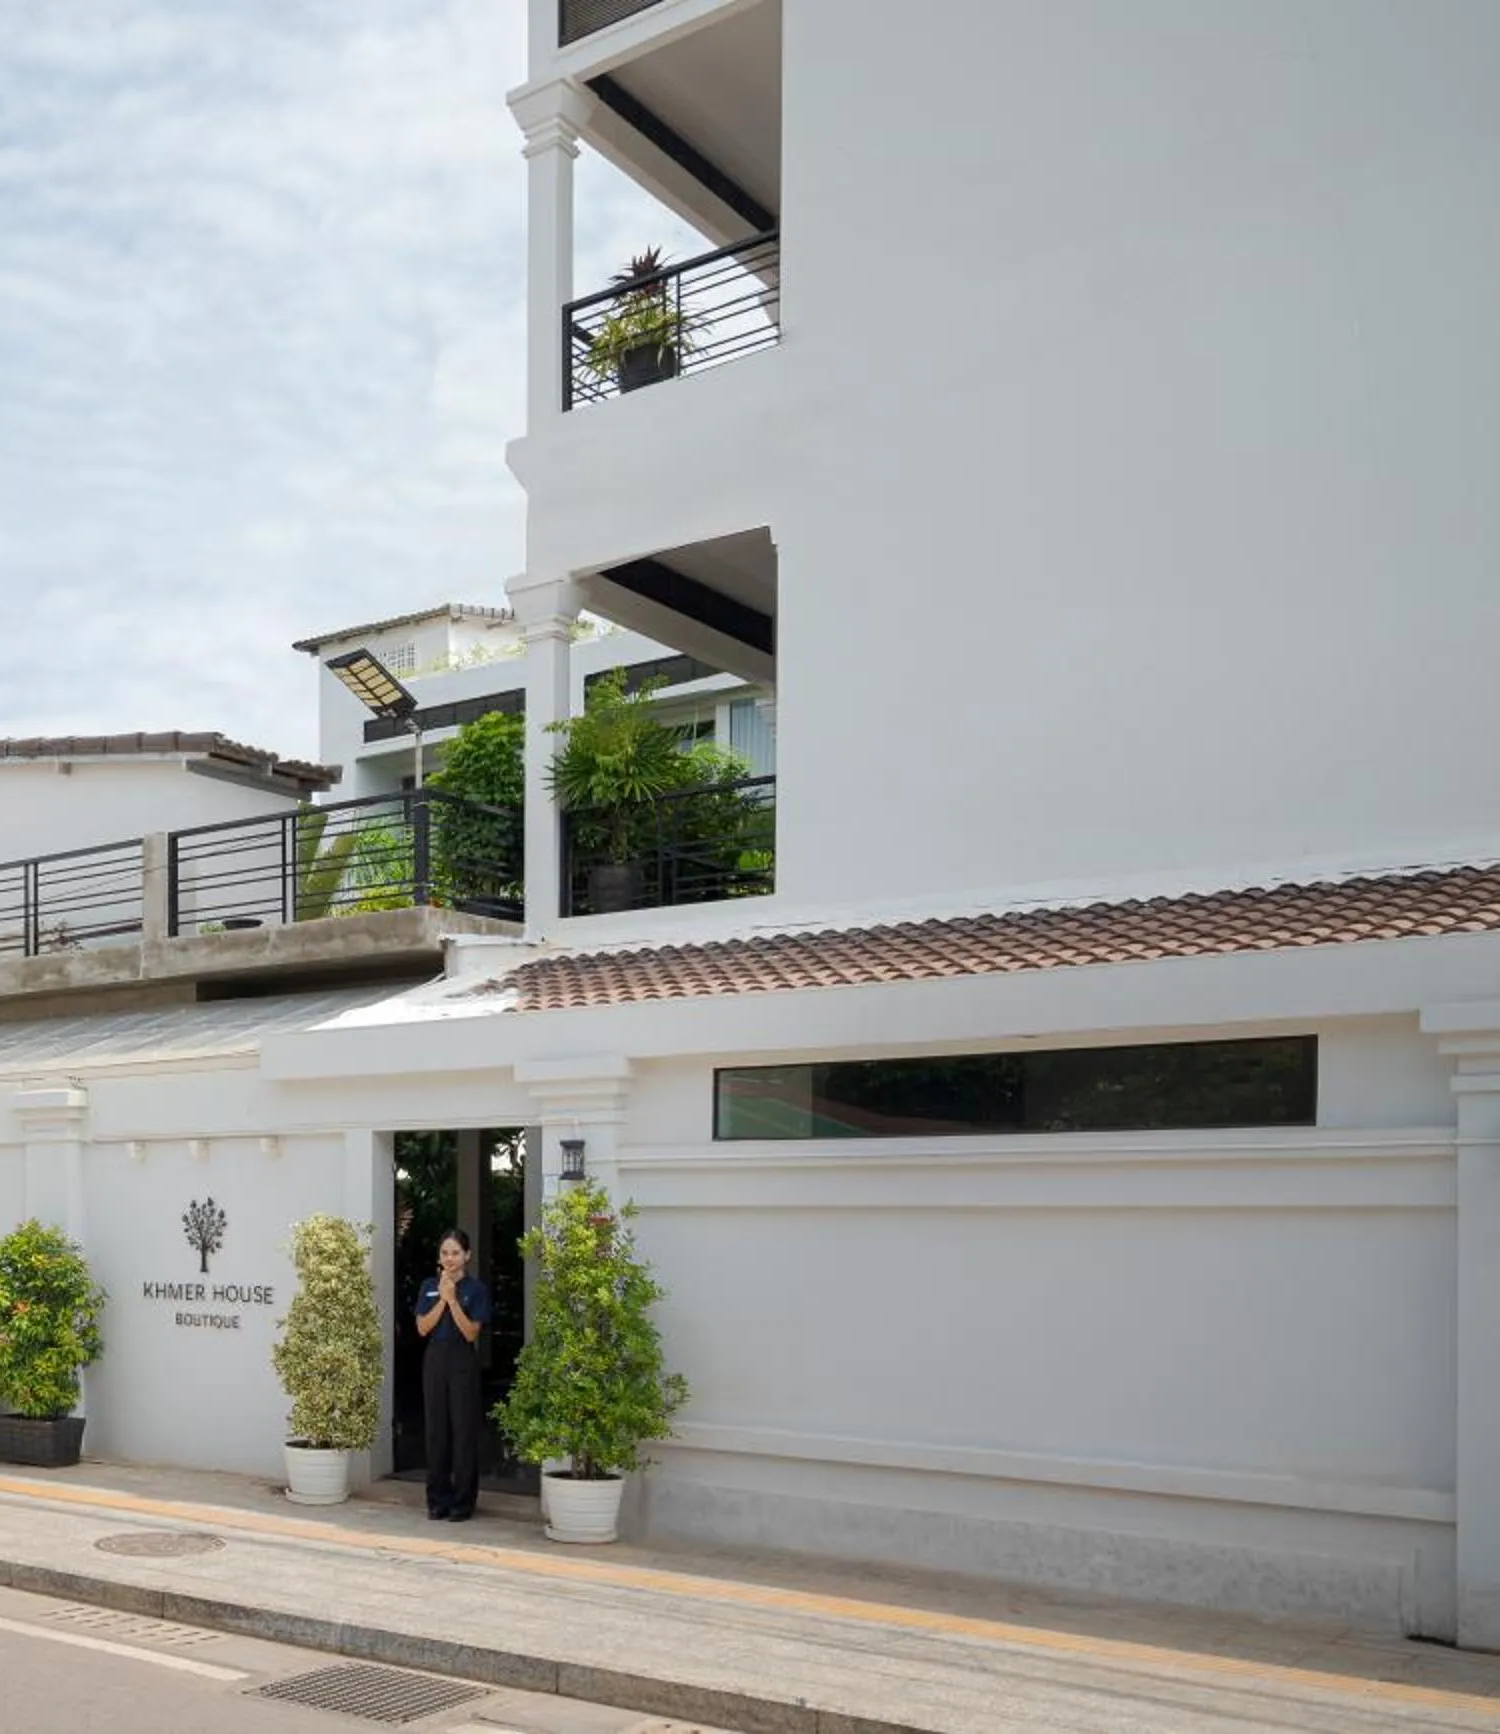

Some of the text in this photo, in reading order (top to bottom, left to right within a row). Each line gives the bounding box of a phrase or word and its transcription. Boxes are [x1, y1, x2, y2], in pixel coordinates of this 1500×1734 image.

[143, 1282, 274, 1304] KHMER HOUSE
[175, 1312, 240, 1329] BOUTIQUE
